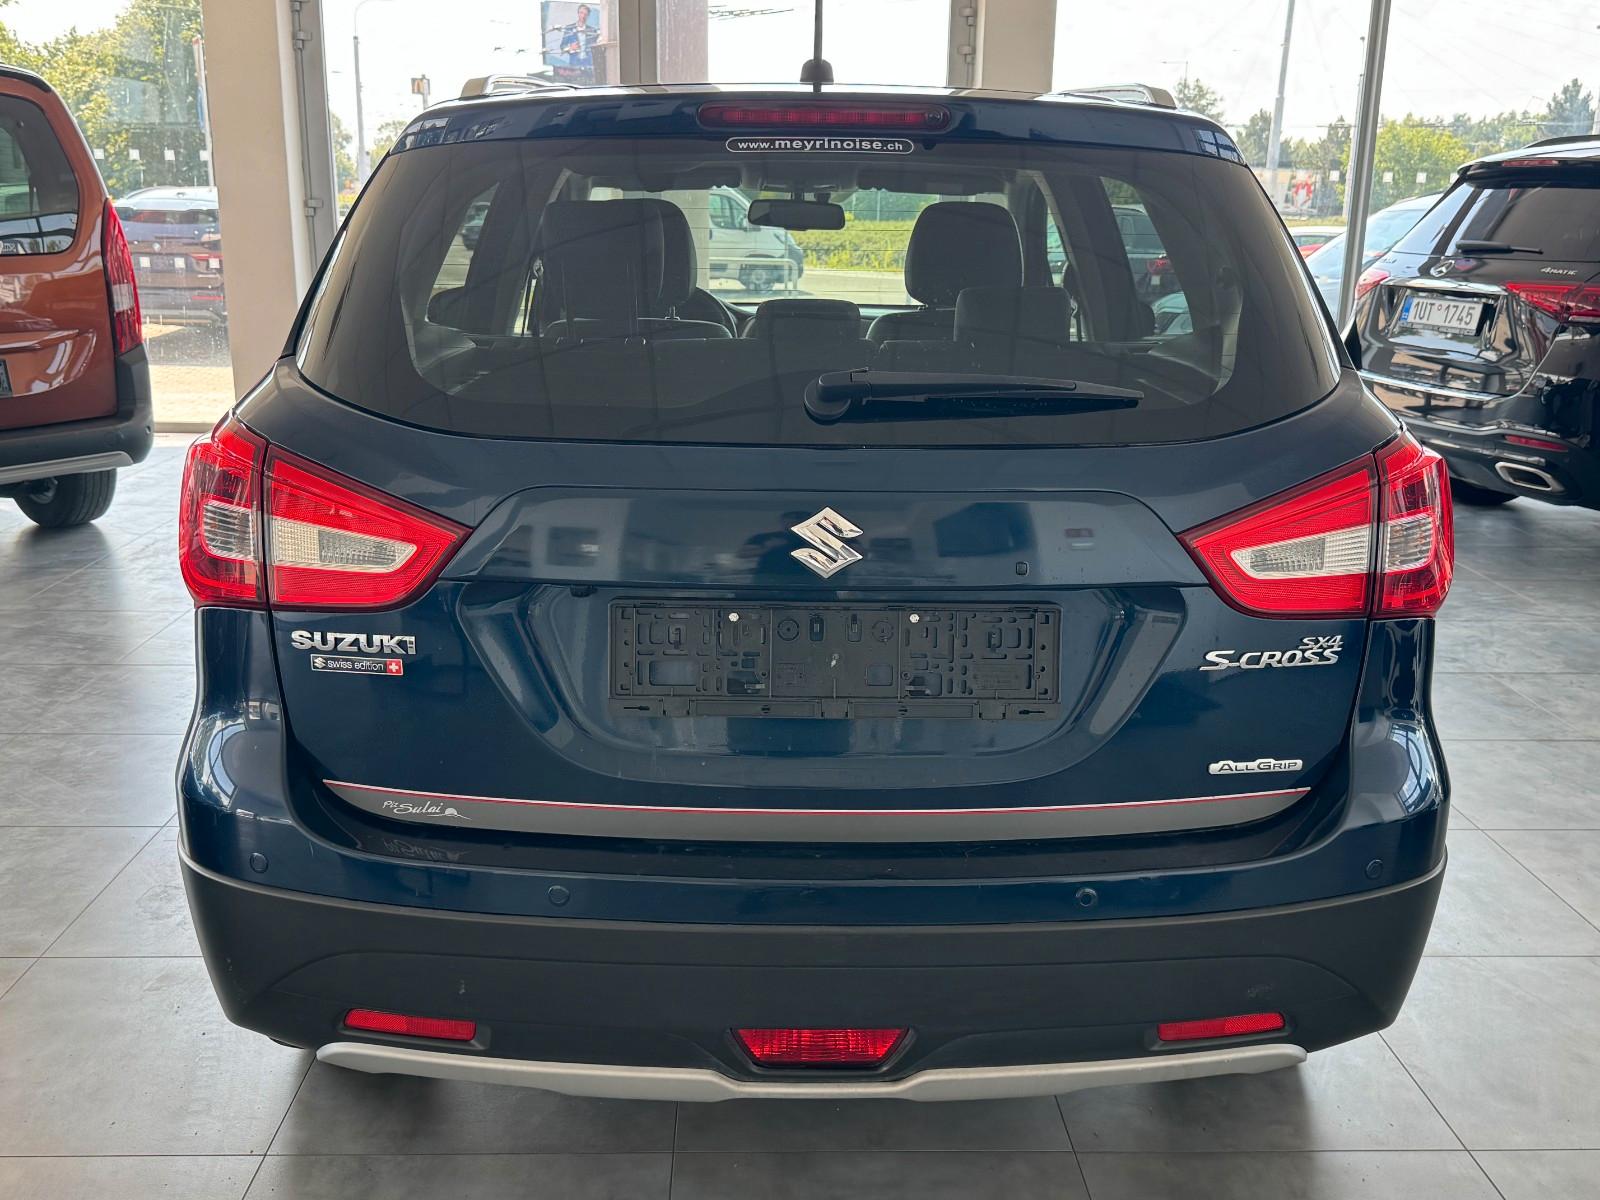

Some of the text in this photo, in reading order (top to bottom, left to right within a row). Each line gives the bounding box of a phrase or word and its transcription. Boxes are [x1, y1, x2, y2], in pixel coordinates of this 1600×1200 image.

[1412, 300, 1476, 326] 1UT 1745
[291, 630, 417, 655] SUZUKI
[1299, 634, 1344, 650] SX4
[327, 658, 384, 671] swiss edition
[393, 801, 444, 814] Sulai
